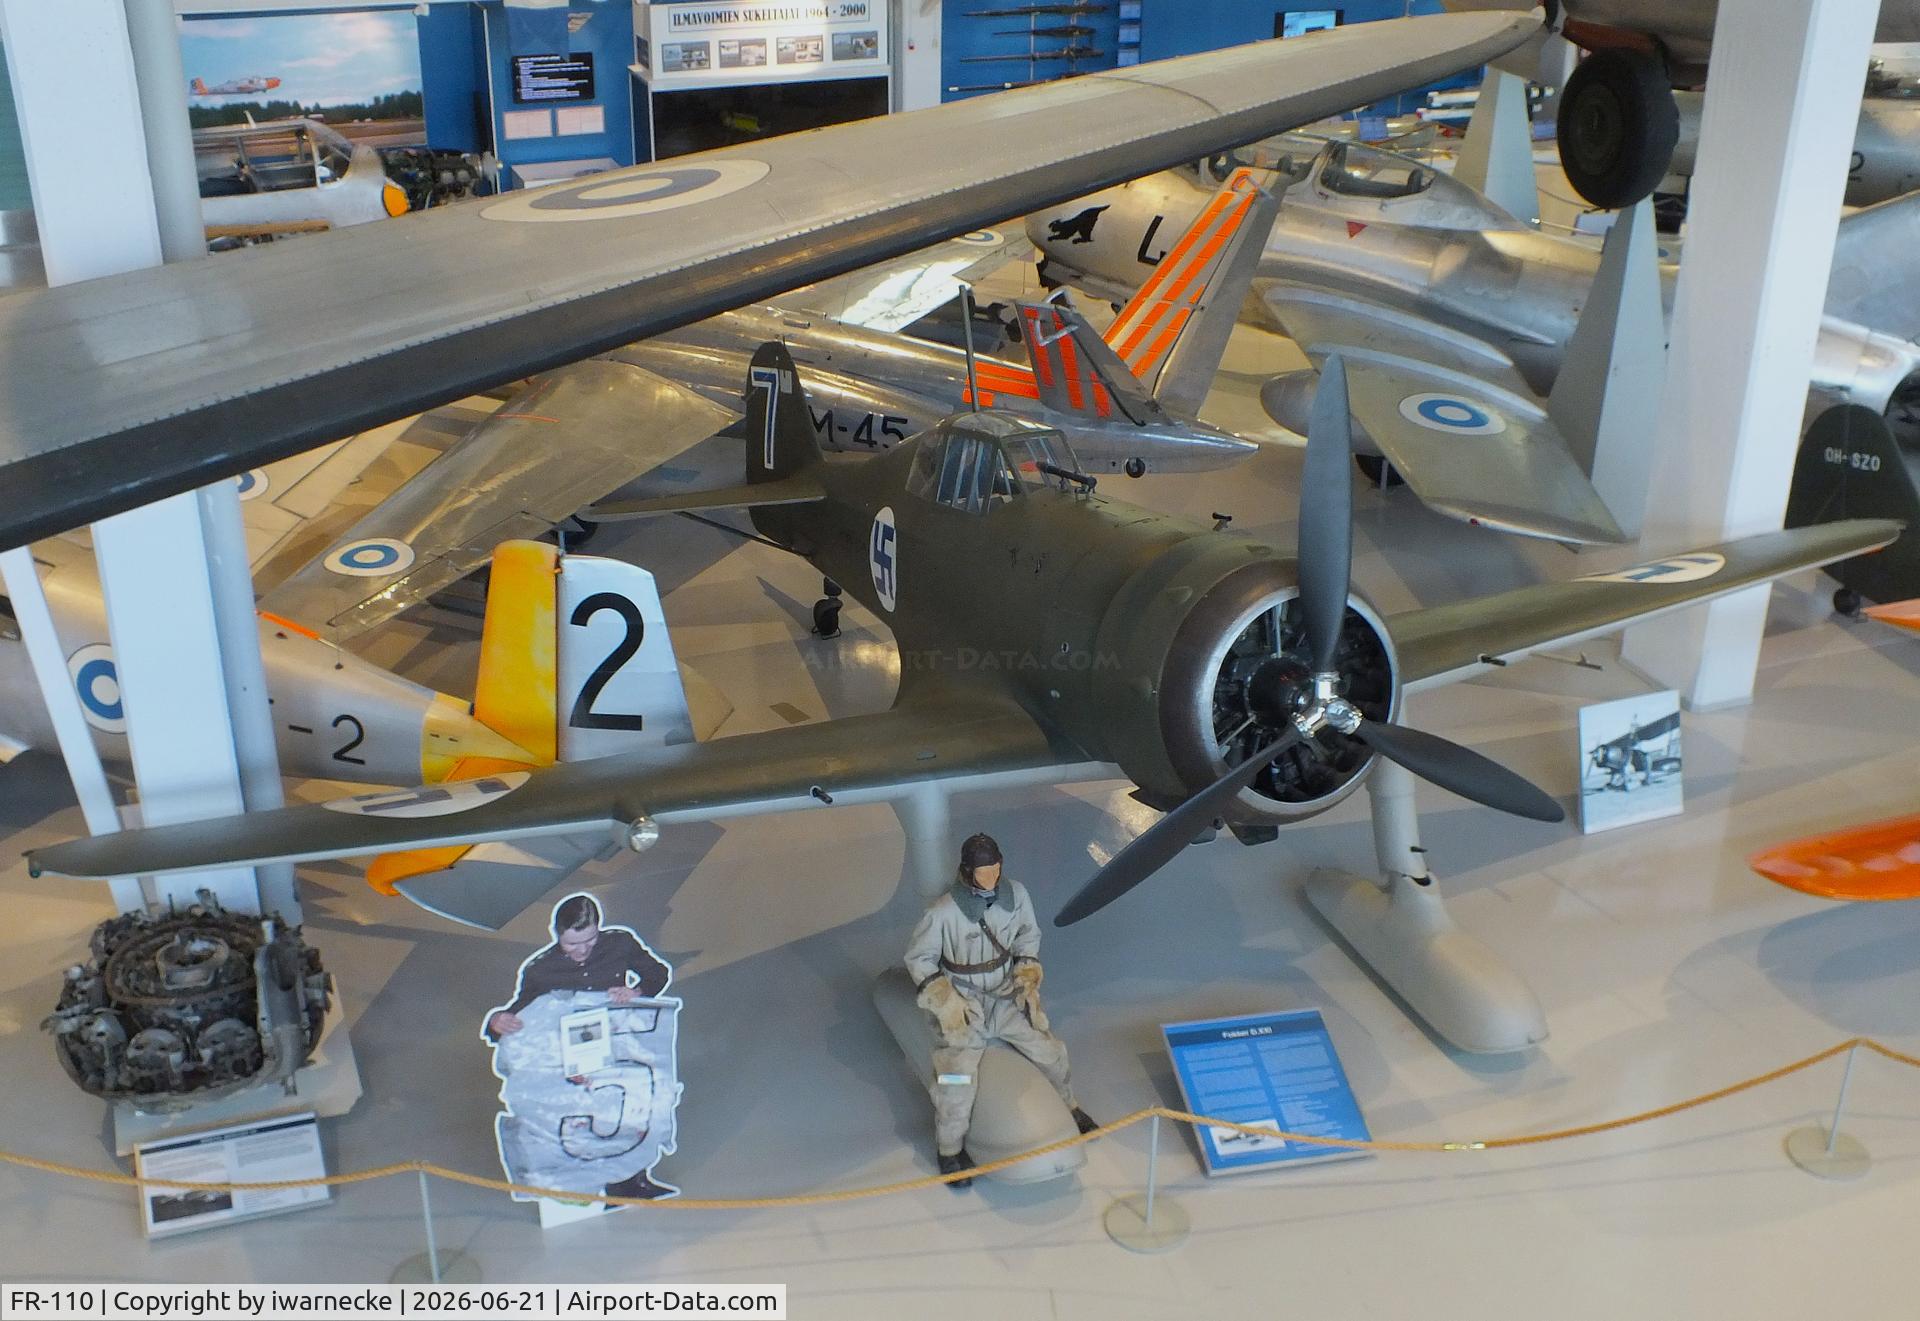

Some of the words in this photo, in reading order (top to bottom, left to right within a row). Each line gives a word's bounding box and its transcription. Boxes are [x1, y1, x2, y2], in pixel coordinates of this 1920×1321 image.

[673, 12, 740, 27] ILMAVOIMIEN
[840, 4, 866, 17] 2000
[751, 366, 778, 469] 7
[569, 592, 644, 731] 2
